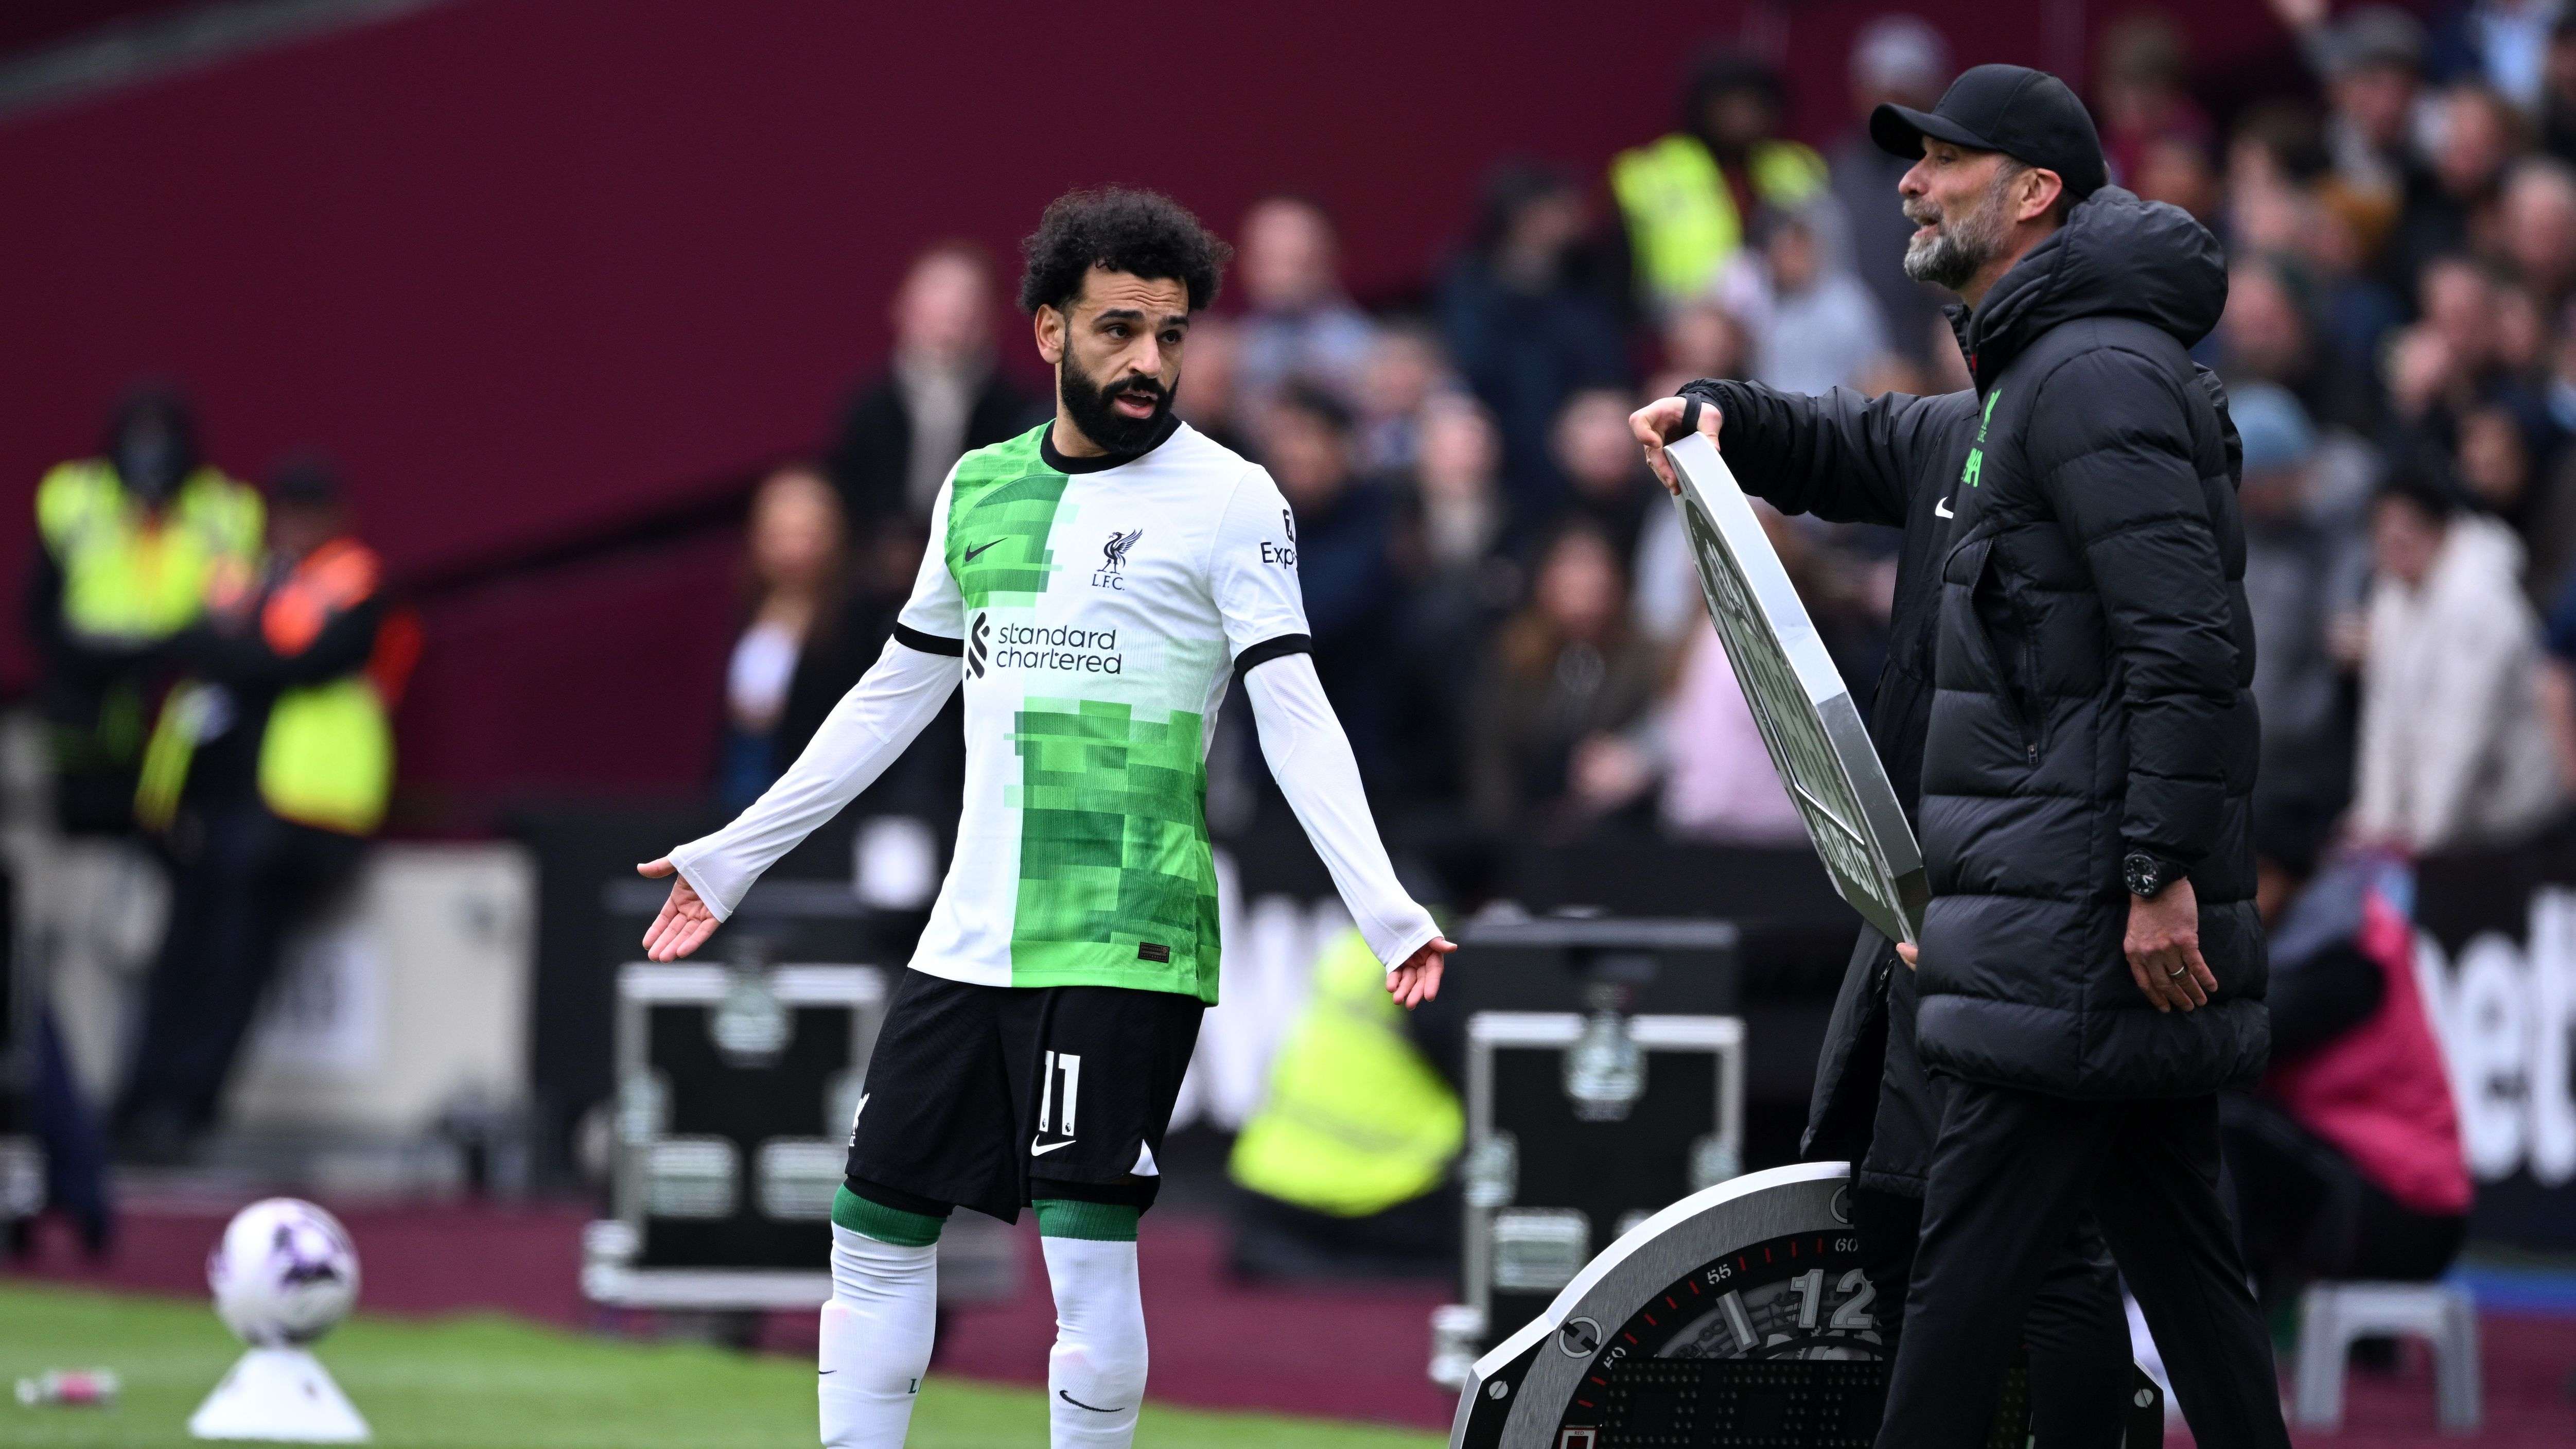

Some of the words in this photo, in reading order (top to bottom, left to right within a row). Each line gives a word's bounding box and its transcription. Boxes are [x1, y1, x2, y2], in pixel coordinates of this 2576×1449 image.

[1260, 542, 1297, 569] Exp
[998, 623, 1116, 650] standard
[996, 647, 1122, 674] chartered
[1806, 804, 1887, 909] HUBLOT
[1039, 1050, 1081, 1137] 11
[1834, 1238, 1859, 1252] 60
[1707, 1263, 1731, 1284] 55
[1790, 1268, 1877, 1329] 12
